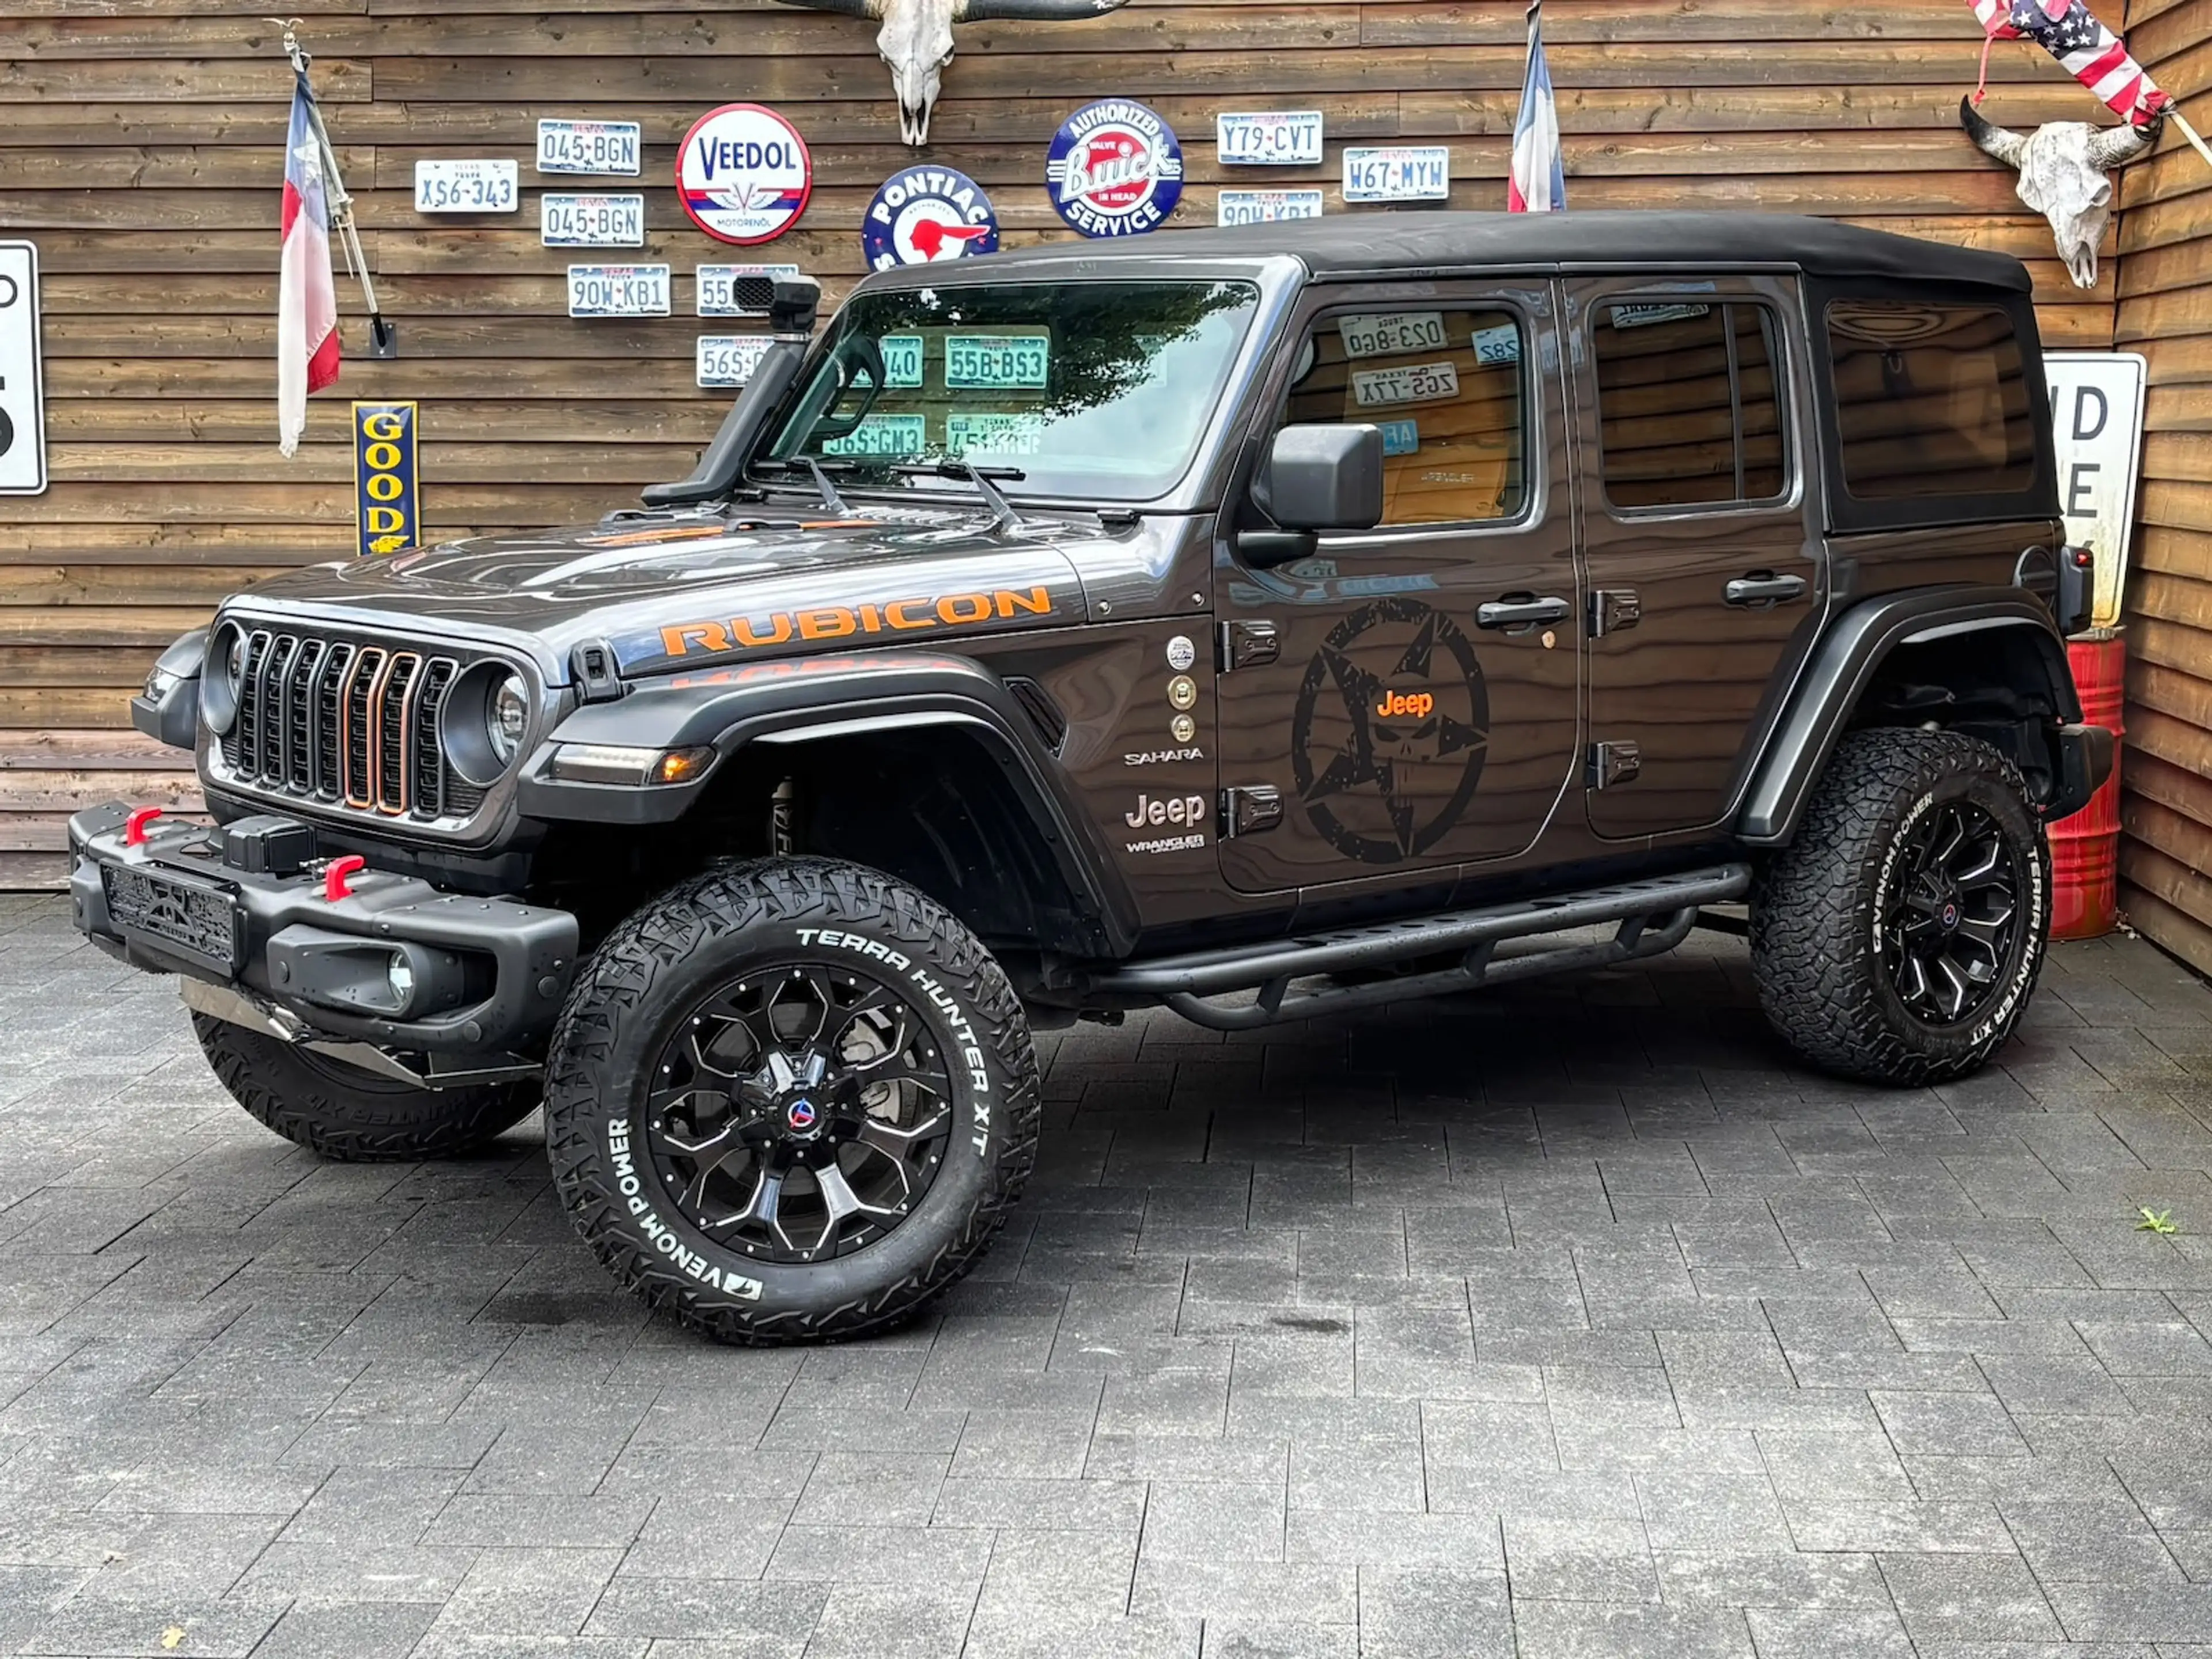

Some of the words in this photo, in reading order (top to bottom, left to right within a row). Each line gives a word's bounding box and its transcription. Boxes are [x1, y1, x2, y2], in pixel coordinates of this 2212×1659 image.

[1069, 104, 1160, 139] AUTHORIZED
[698, 136, 797, 181] VEEDOL
[1059, 133, 1181, 203] Buick
[872, 172, 989, 225] PONTIAC
[1066, 200, 1162, 236] SERVICE
[363, 412, 404, 533] GOOD
[660, 586, 1052, 656] RUBICON
[1377, 690, 1433, 718] Jeep
[1124, 747, 1204, 766] SAHARA
[1125, 794, 1206, 828] Jeep
[1126, 834, 1205, 853] WRANGLER
[1873, 846, 1896, 923] VENOM
[1892, 791, 1933, 848] POWER
[2027, 845, 2042, 930] TERRA
[1993, 934, 2038, 1025] HUNTER
[796, 928, 911, 972] TERRA
[910, 968, 990, 1093] HUNTER
